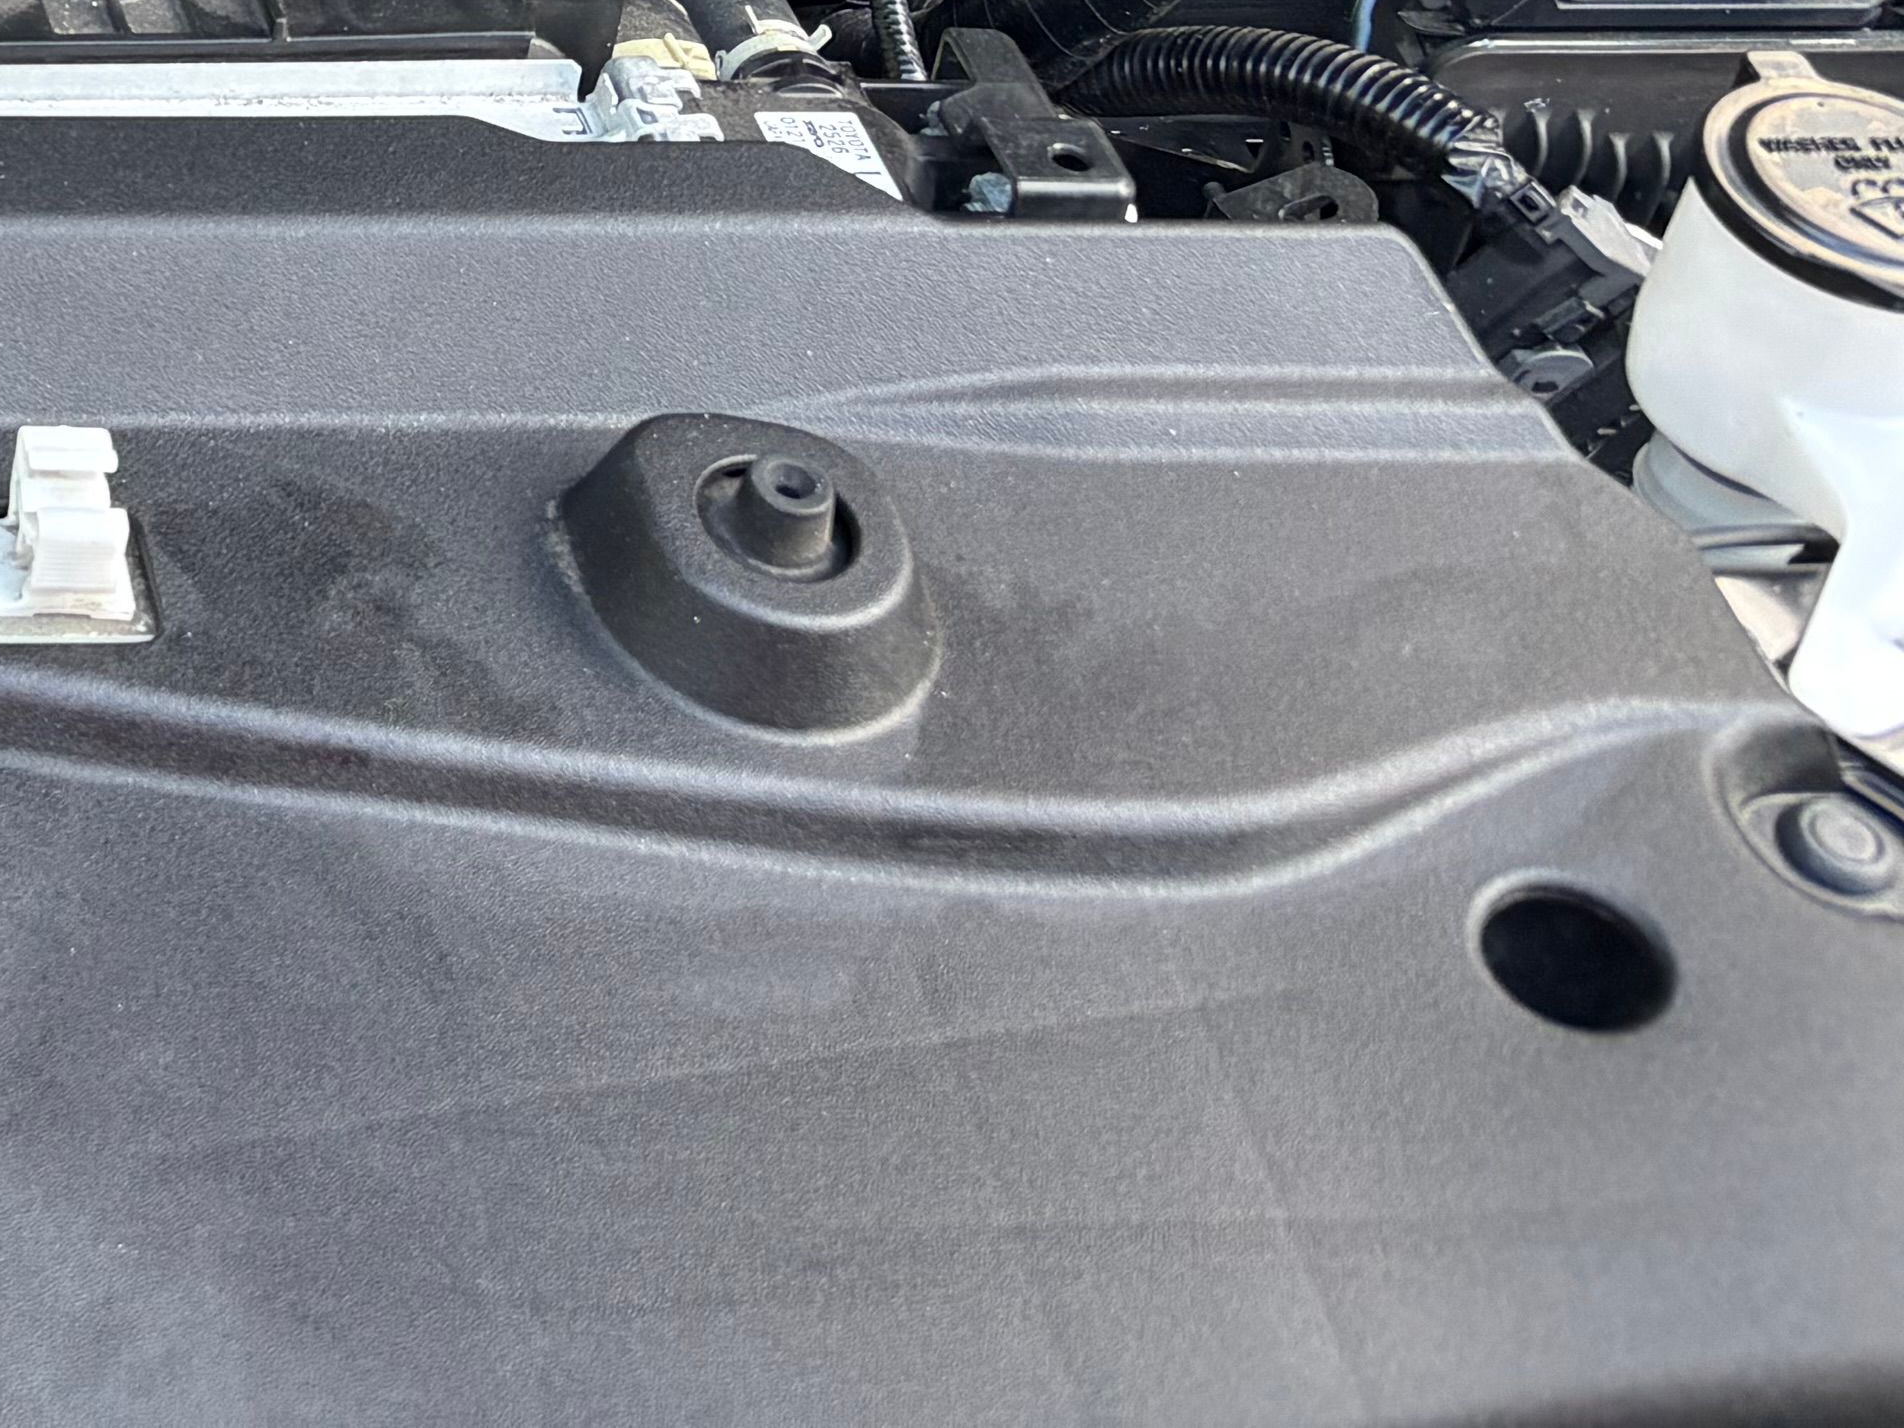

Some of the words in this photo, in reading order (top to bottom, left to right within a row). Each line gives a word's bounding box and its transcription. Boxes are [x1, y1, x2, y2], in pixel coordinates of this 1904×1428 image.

[838, 119, 872, 161] TOYOTA
[1758, 136, 1862, 154] WASHER
[1833, 155, 1891, 171] ONLY
